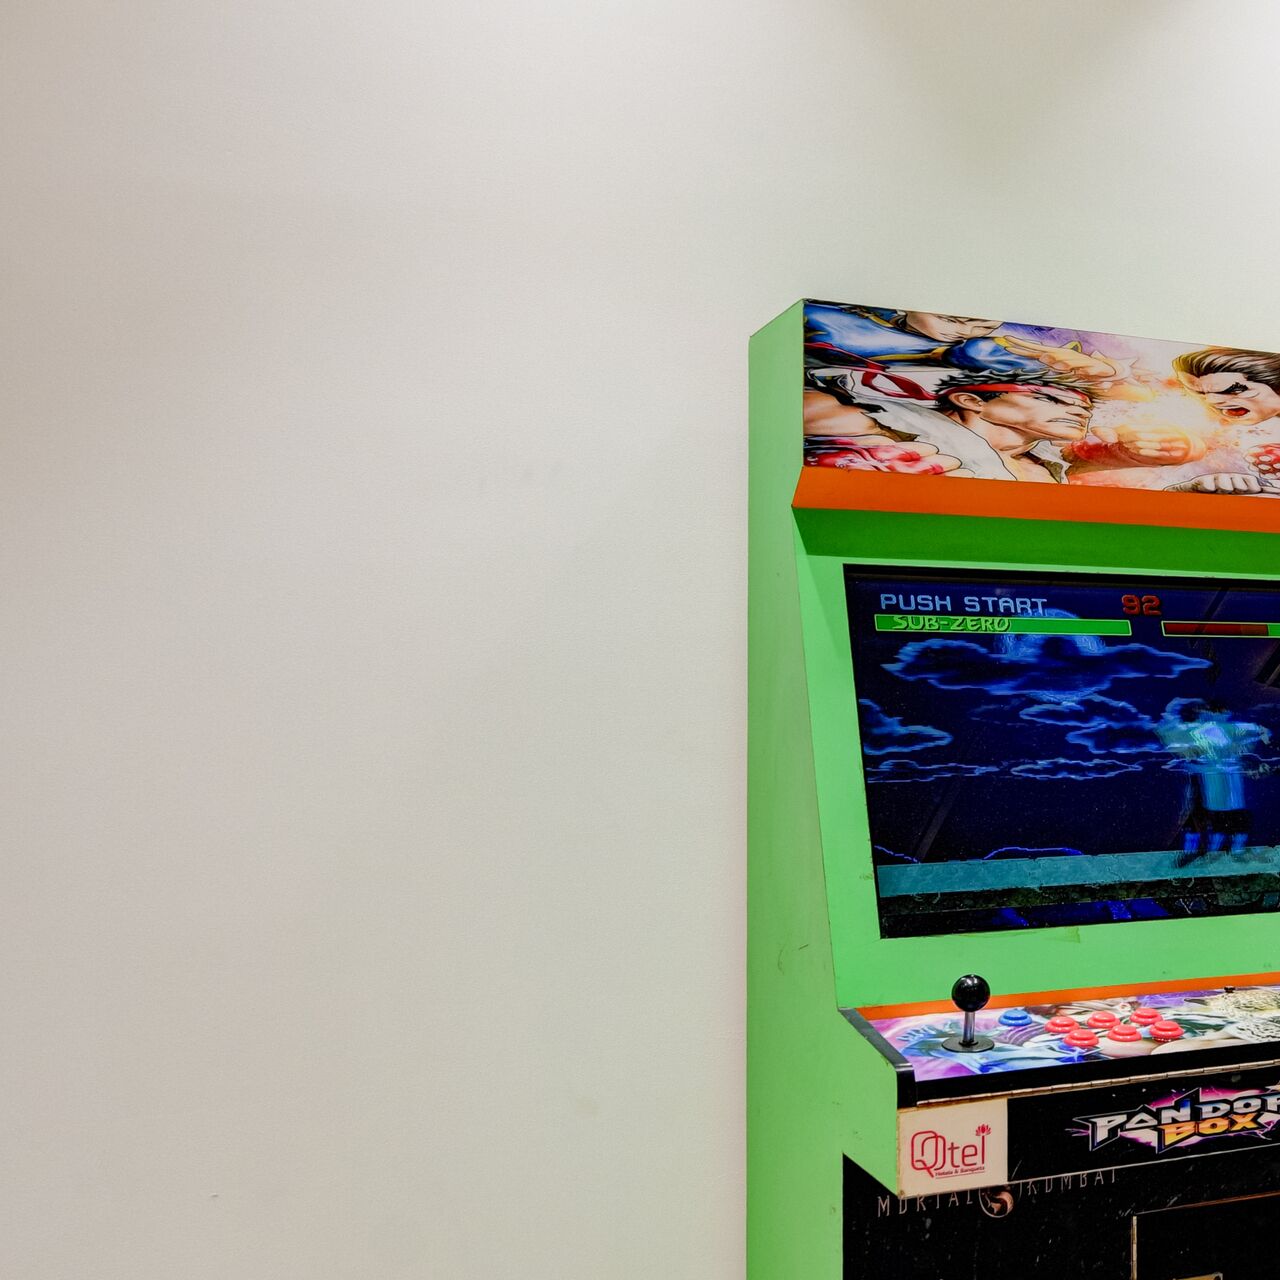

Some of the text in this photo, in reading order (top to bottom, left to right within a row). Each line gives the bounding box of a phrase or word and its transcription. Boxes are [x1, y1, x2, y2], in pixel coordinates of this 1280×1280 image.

[880, 593, 1047, 614] PUSH START
[1121, 594, 1161, 616] 92
[892, 615, 1010, 632] SUB-ZERO
[1158, 1113, 1262, 1148] BOX
